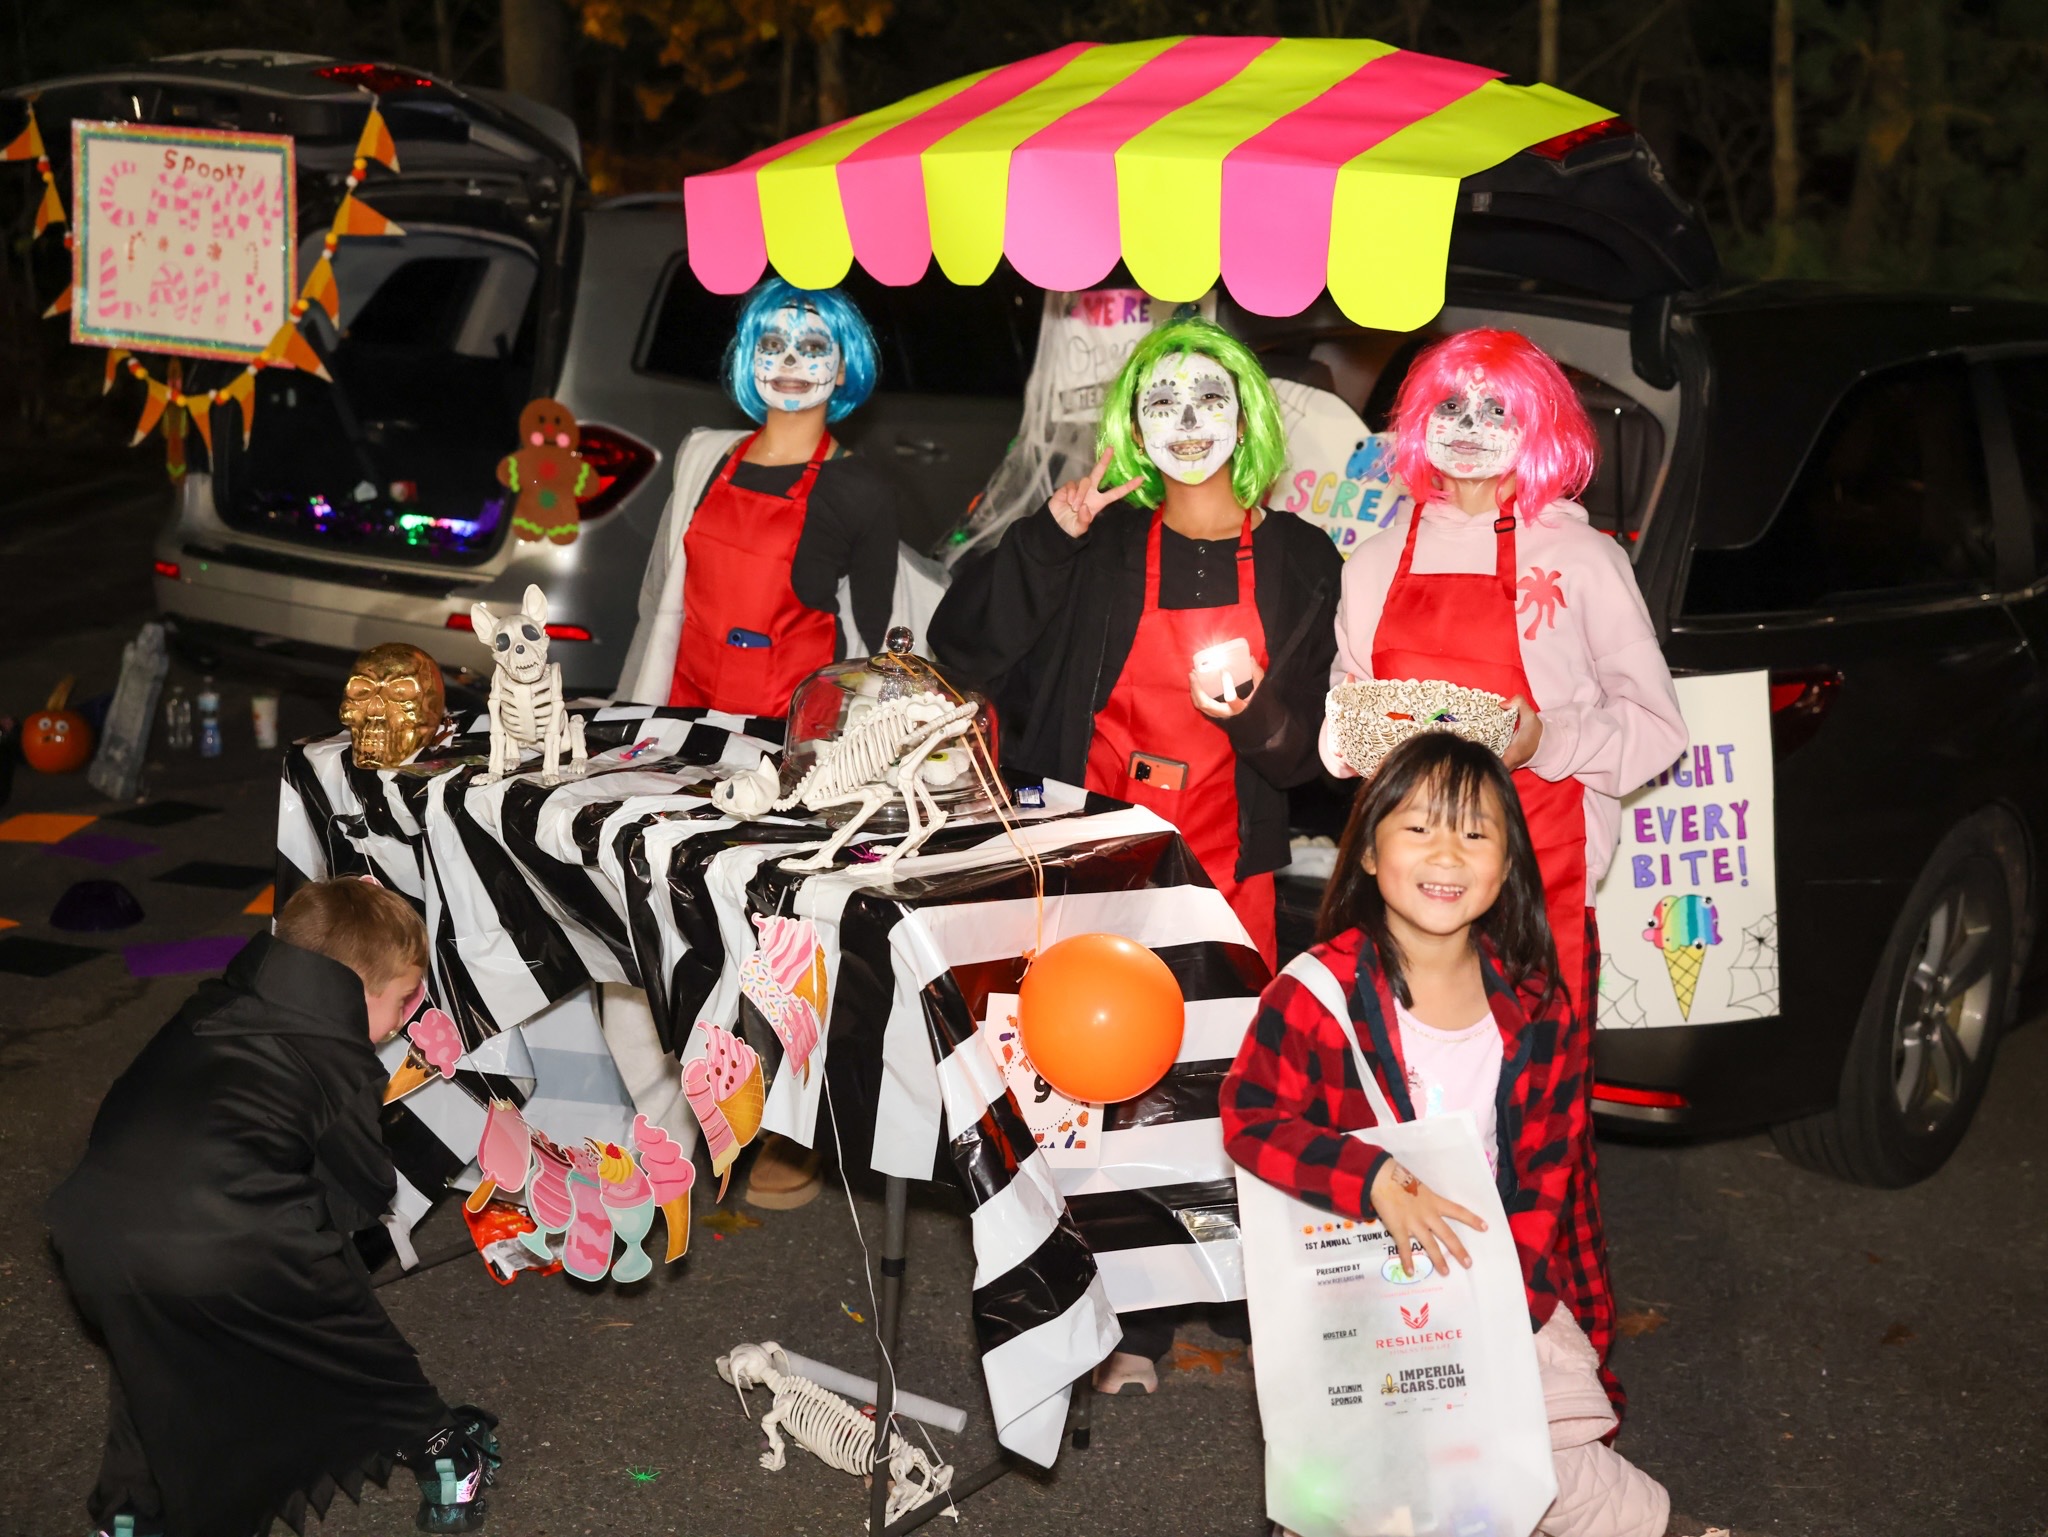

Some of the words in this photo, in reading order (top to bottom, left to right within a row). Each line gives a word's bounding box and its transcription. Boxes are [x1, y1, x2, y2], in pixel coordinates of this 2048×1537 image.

[98, 246, 274, 336] LAND
[1320, 524, 1357, 546] ND
[1640, 744, 1735, 788] GHT
[1633, 799, 1749, 845] EVERY
[1631, 846, 1749, 889] BITE!
[1033, 1073, 1053, 1104] 9
[1320, 1237, 1352, 1249] ANNUAL
[1316, 1265, 1351, 1276] PRESENTED
[1352, 1263, 1361, 1271] BY
[1323, 1330, 1347, 1341] HOSTED
[1348, 1329, 1358, 1338] AT
[1375, 1329, 1463, 1349] RESILIENCE
[1399, 1363, 1465, 1382] IMPERIAL
[1328, 1384, 1363, 1395] PLATINUM
[1400, 1375, 1467, 1394] CARS.COM
[1331, 1395, 1363, 1406] SPONSOR
